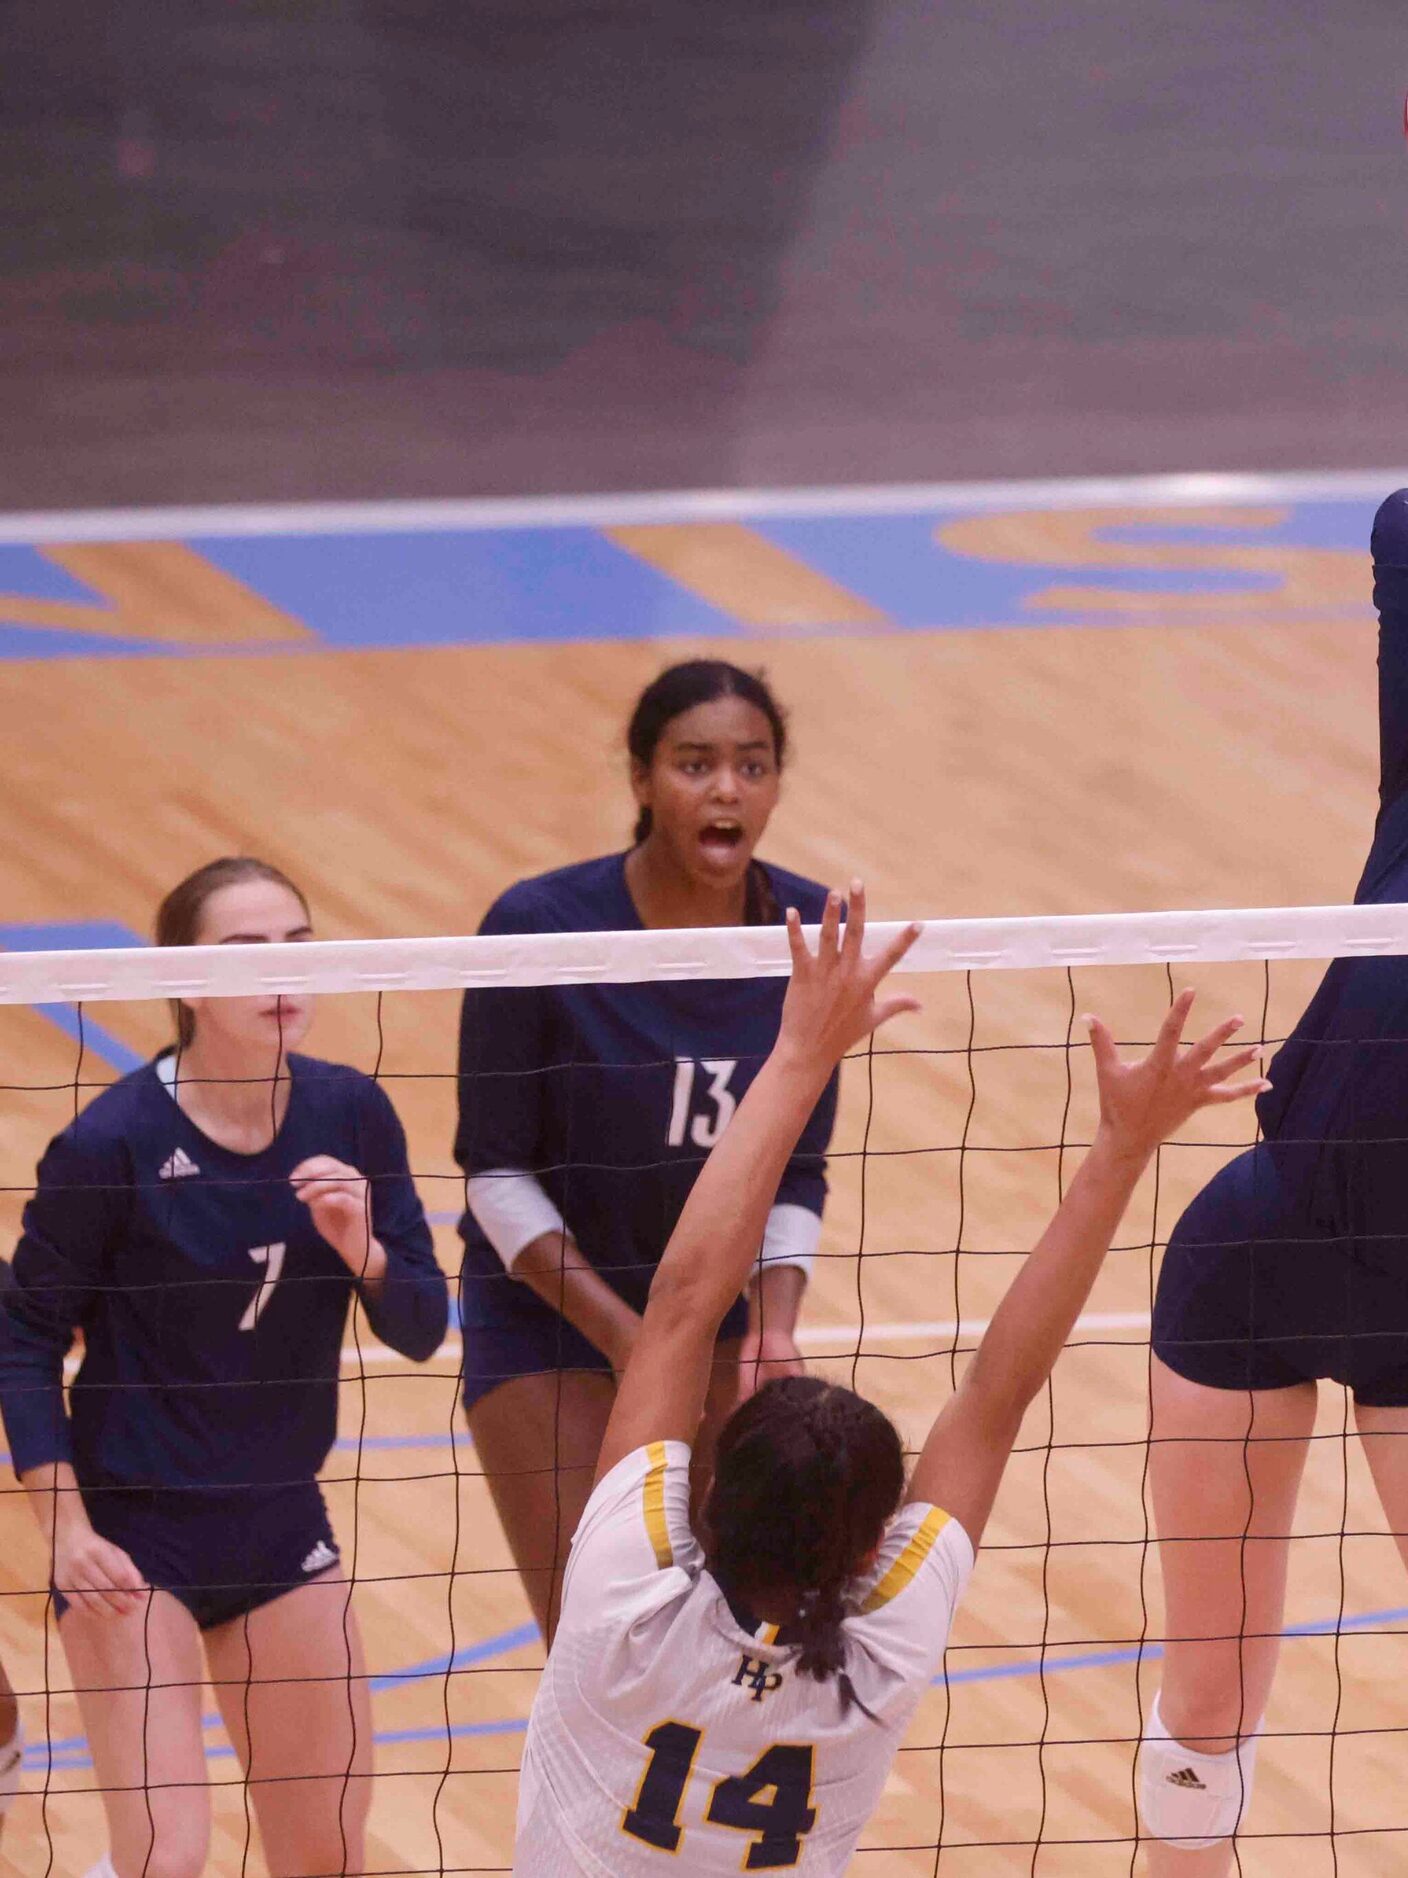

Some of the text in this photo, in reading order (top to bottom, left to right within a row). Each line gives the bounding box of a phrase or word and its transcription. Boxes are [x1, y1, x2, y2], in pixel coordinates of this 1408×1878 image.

[668, 1056, 738, 1148] 13
[238, 1242, 287, 1331] 7
[731, 1654, 783, 1702] HP
[620, 1715, 820, 1874] 14
